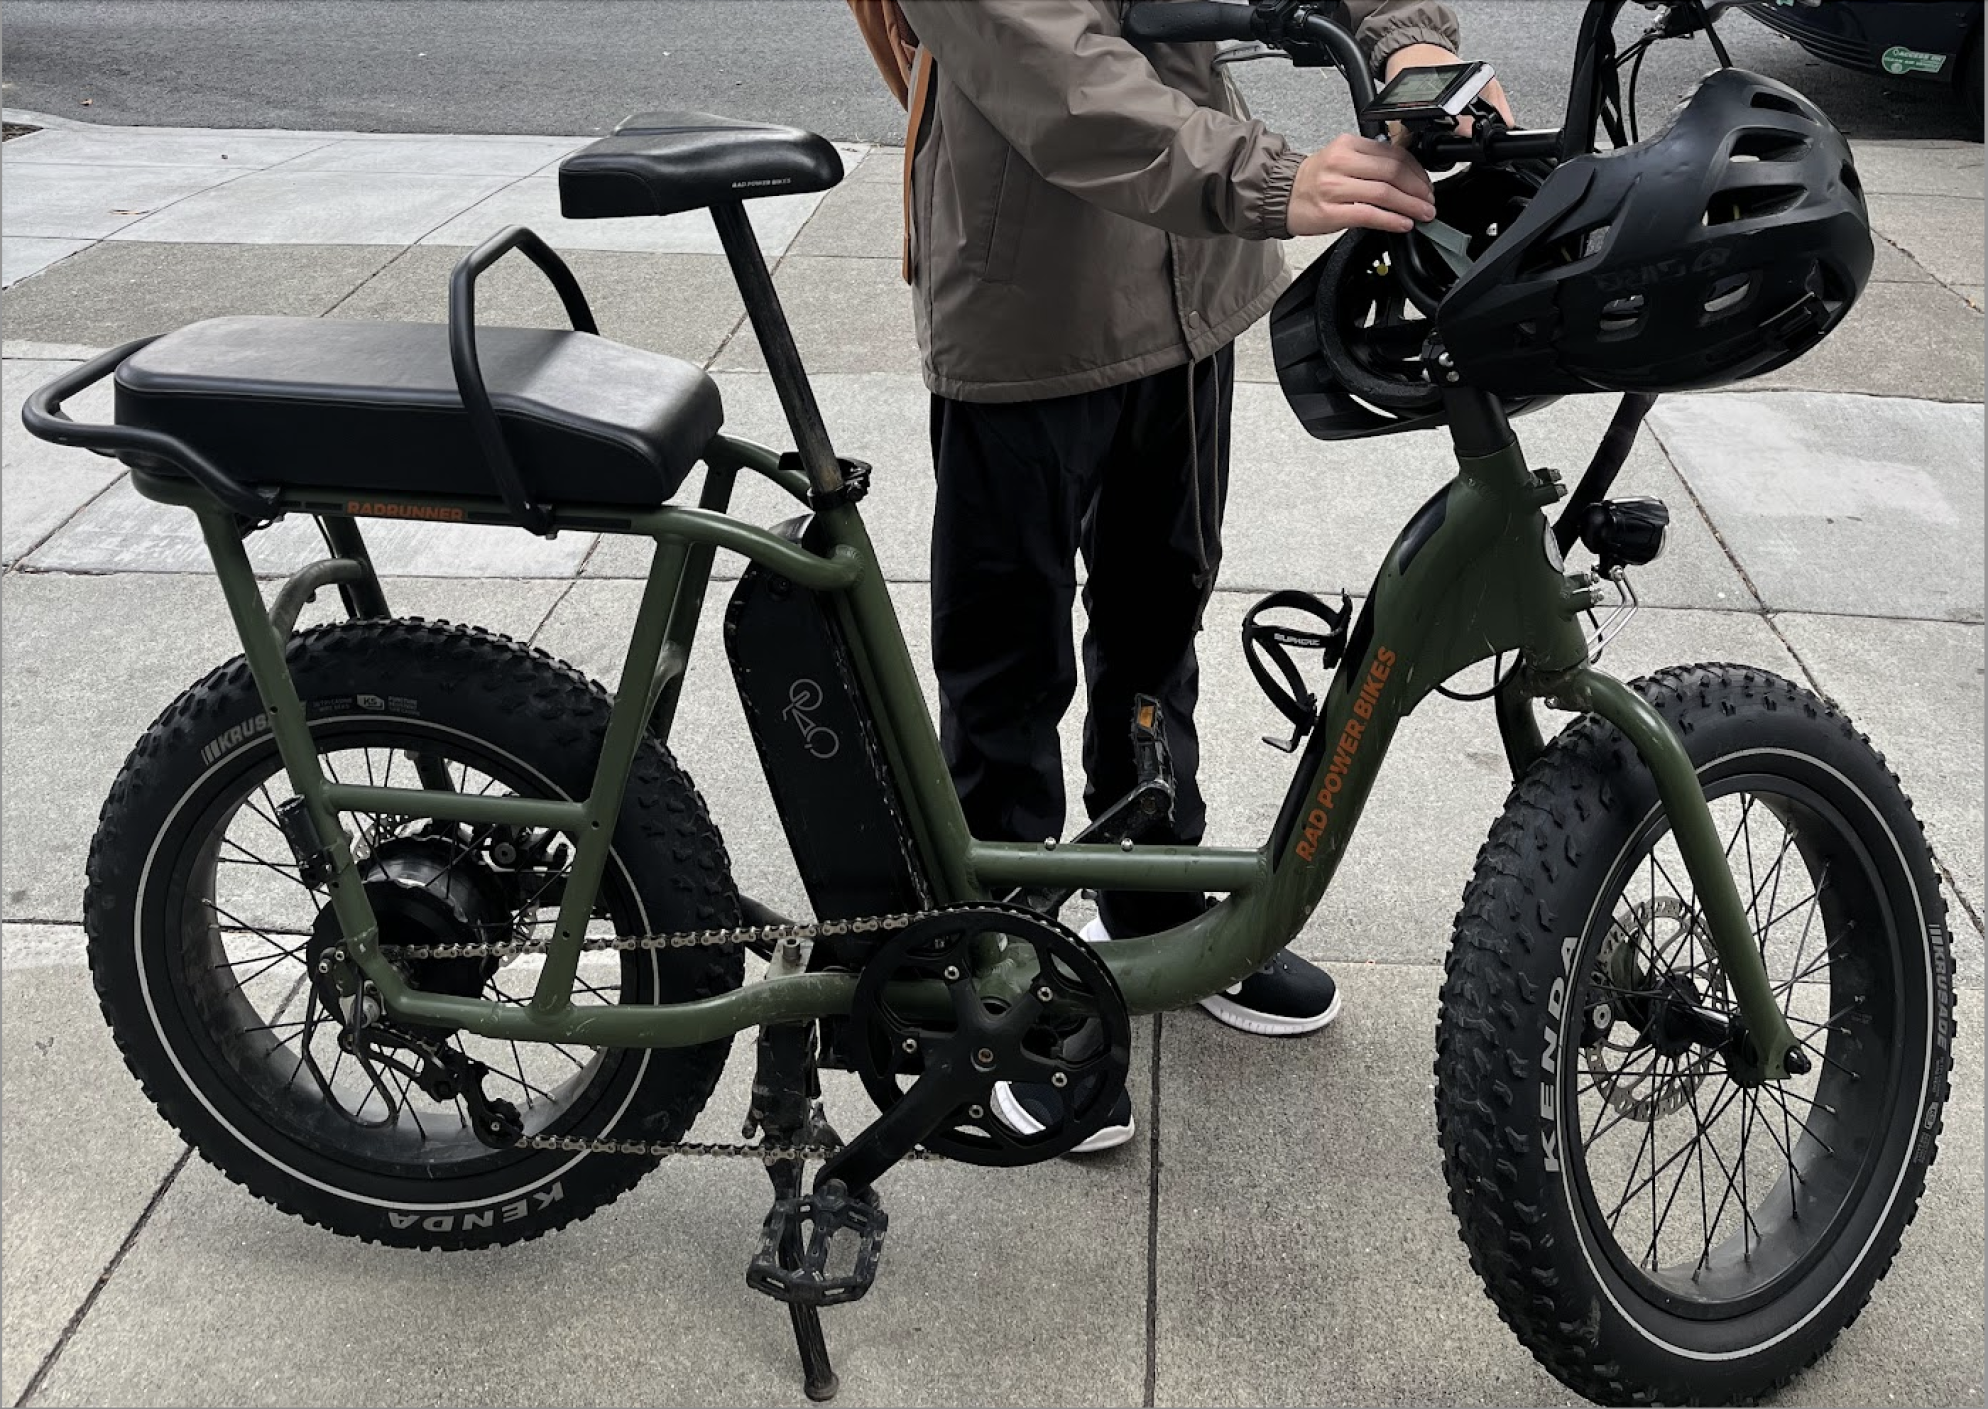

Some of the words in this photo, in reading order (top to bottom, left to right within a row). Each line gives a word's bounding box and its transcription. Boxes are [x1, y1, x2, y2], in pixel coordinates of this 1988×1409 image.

[347, 500, 463, 520] RADRUNNER
[209, 713, 271, 754] KRUS
[1296, 808, 1328, 861] RAD
[1317, 719, 1365, 809] POWER
[1353, 646, 1396, 720] BIKES
[1932, 945, 1949, 1051] KRUSADE
[1540, 936, 1578, 1172] KENDA
[388, 1181, 564, 1232] KENDA
